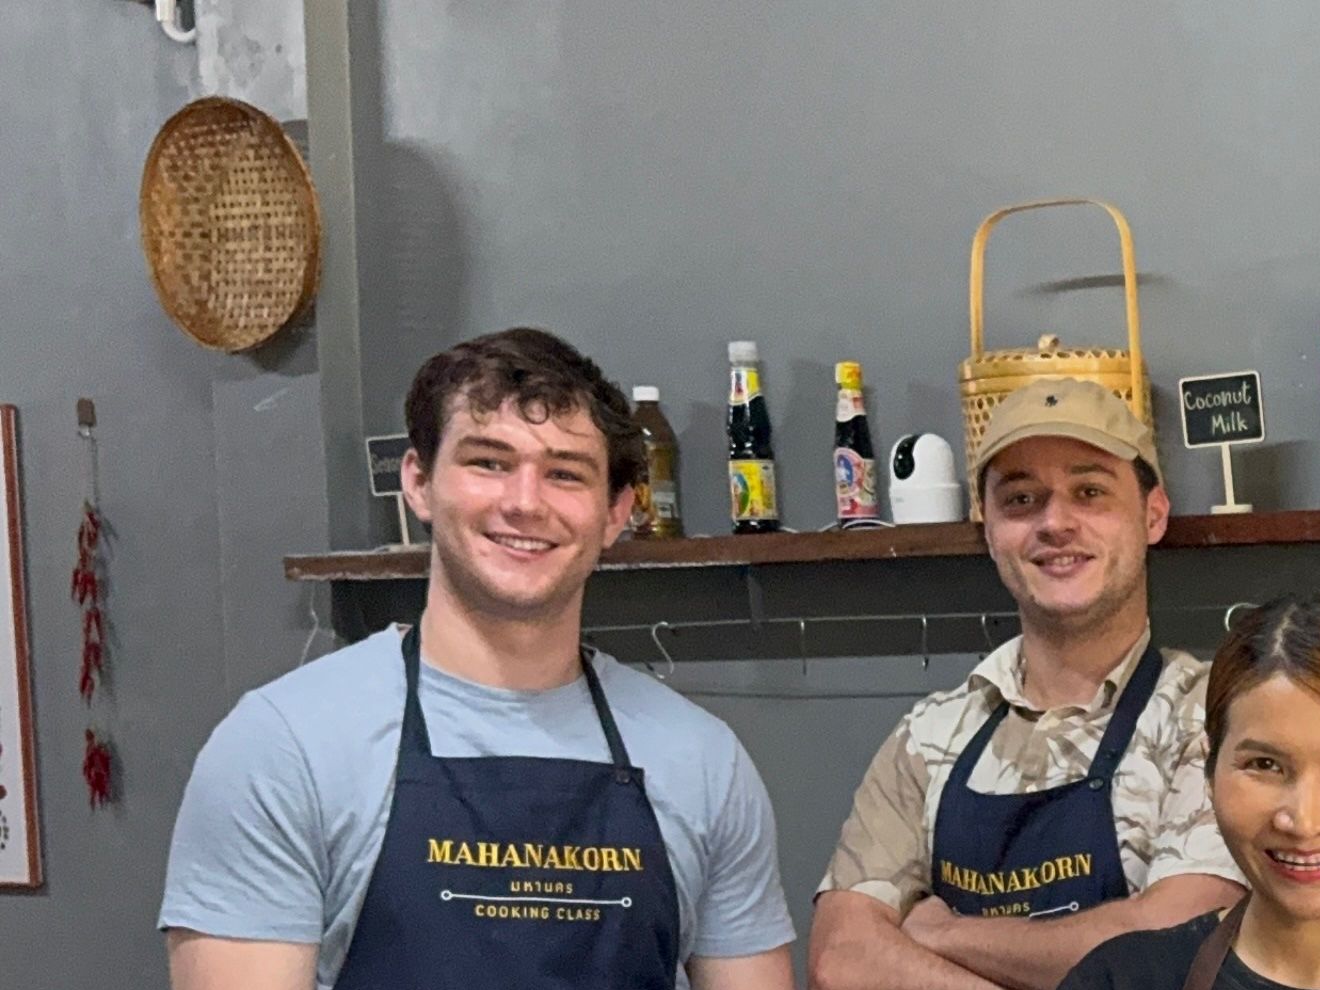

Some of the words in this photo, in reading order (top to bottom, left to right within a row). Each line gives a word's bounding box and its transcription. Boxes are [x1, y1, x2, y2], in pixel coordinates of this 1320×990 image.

[1184, 380, 1252, 410] Coconut
[1211, 411, 1248, 436] Milk
[427, 838, 644, 871] MAHANAKORN
[940, 852, 1092, 895] MAHANAKORN
[474, 904, 550, 920] COOKING
[556, 907, 601, 921] CLASS
